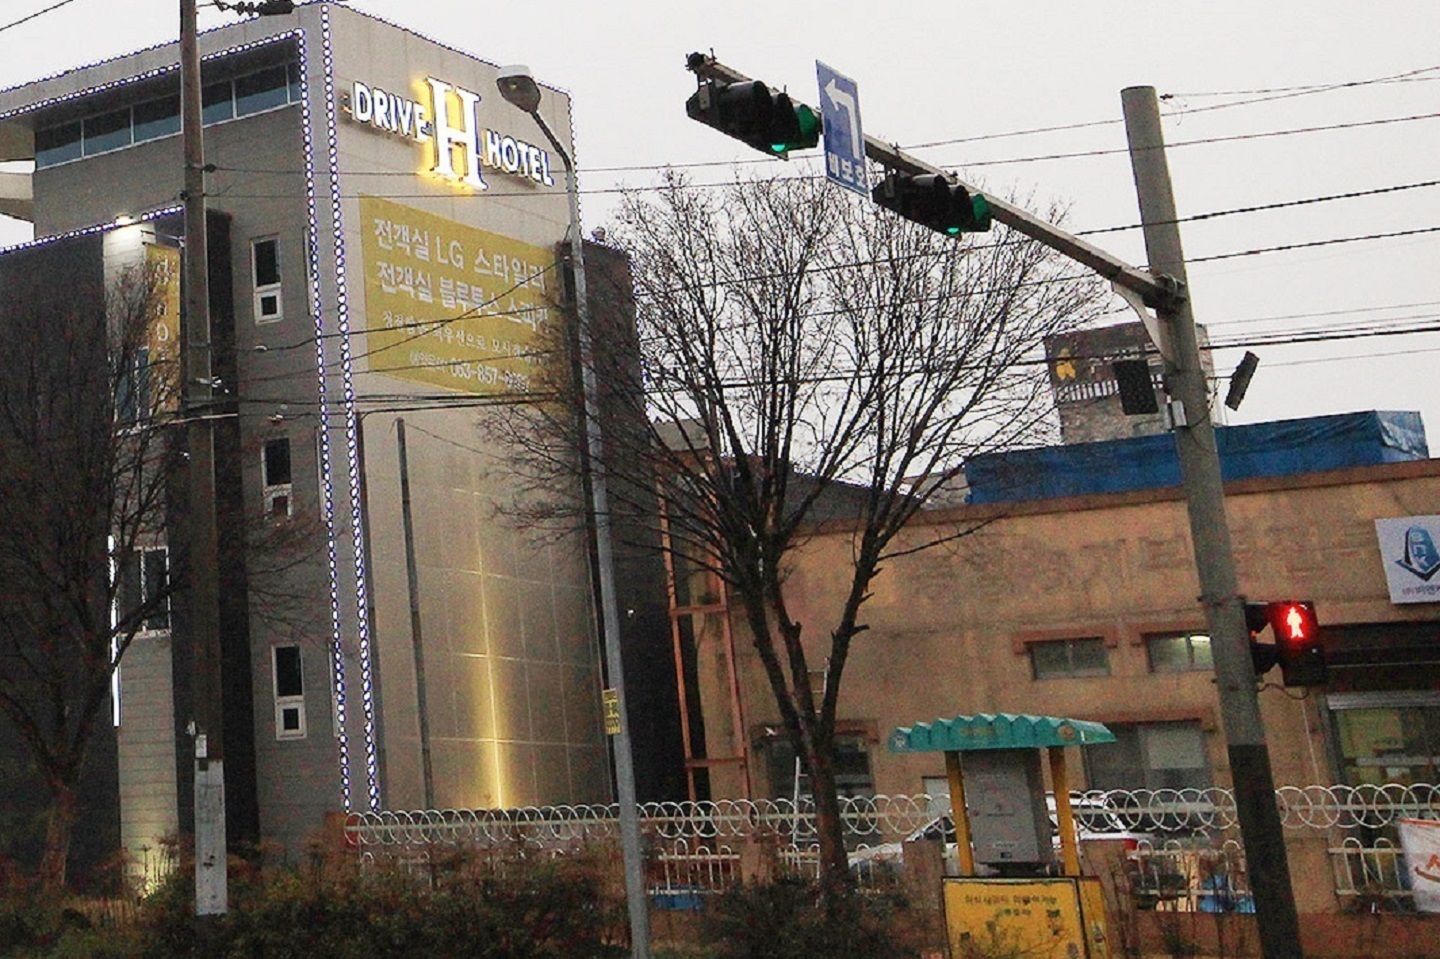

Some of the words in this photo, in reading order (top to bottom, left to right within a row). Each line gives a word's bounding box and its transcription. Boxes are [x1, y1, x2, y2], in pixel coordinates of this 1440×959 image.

[352, 81, 432, 142] DRIVE
[423, 76, 488, 191] H
[484, 129, 555, 187] HOTEL
[374, 218, 430, 261] 전객실
[436, 235, 464, 269] LG
[473, 248, 546, 295] 스타일러
[376, 261, 433, 304] 전객실
[440, 276, 502, 319] 블루투스
